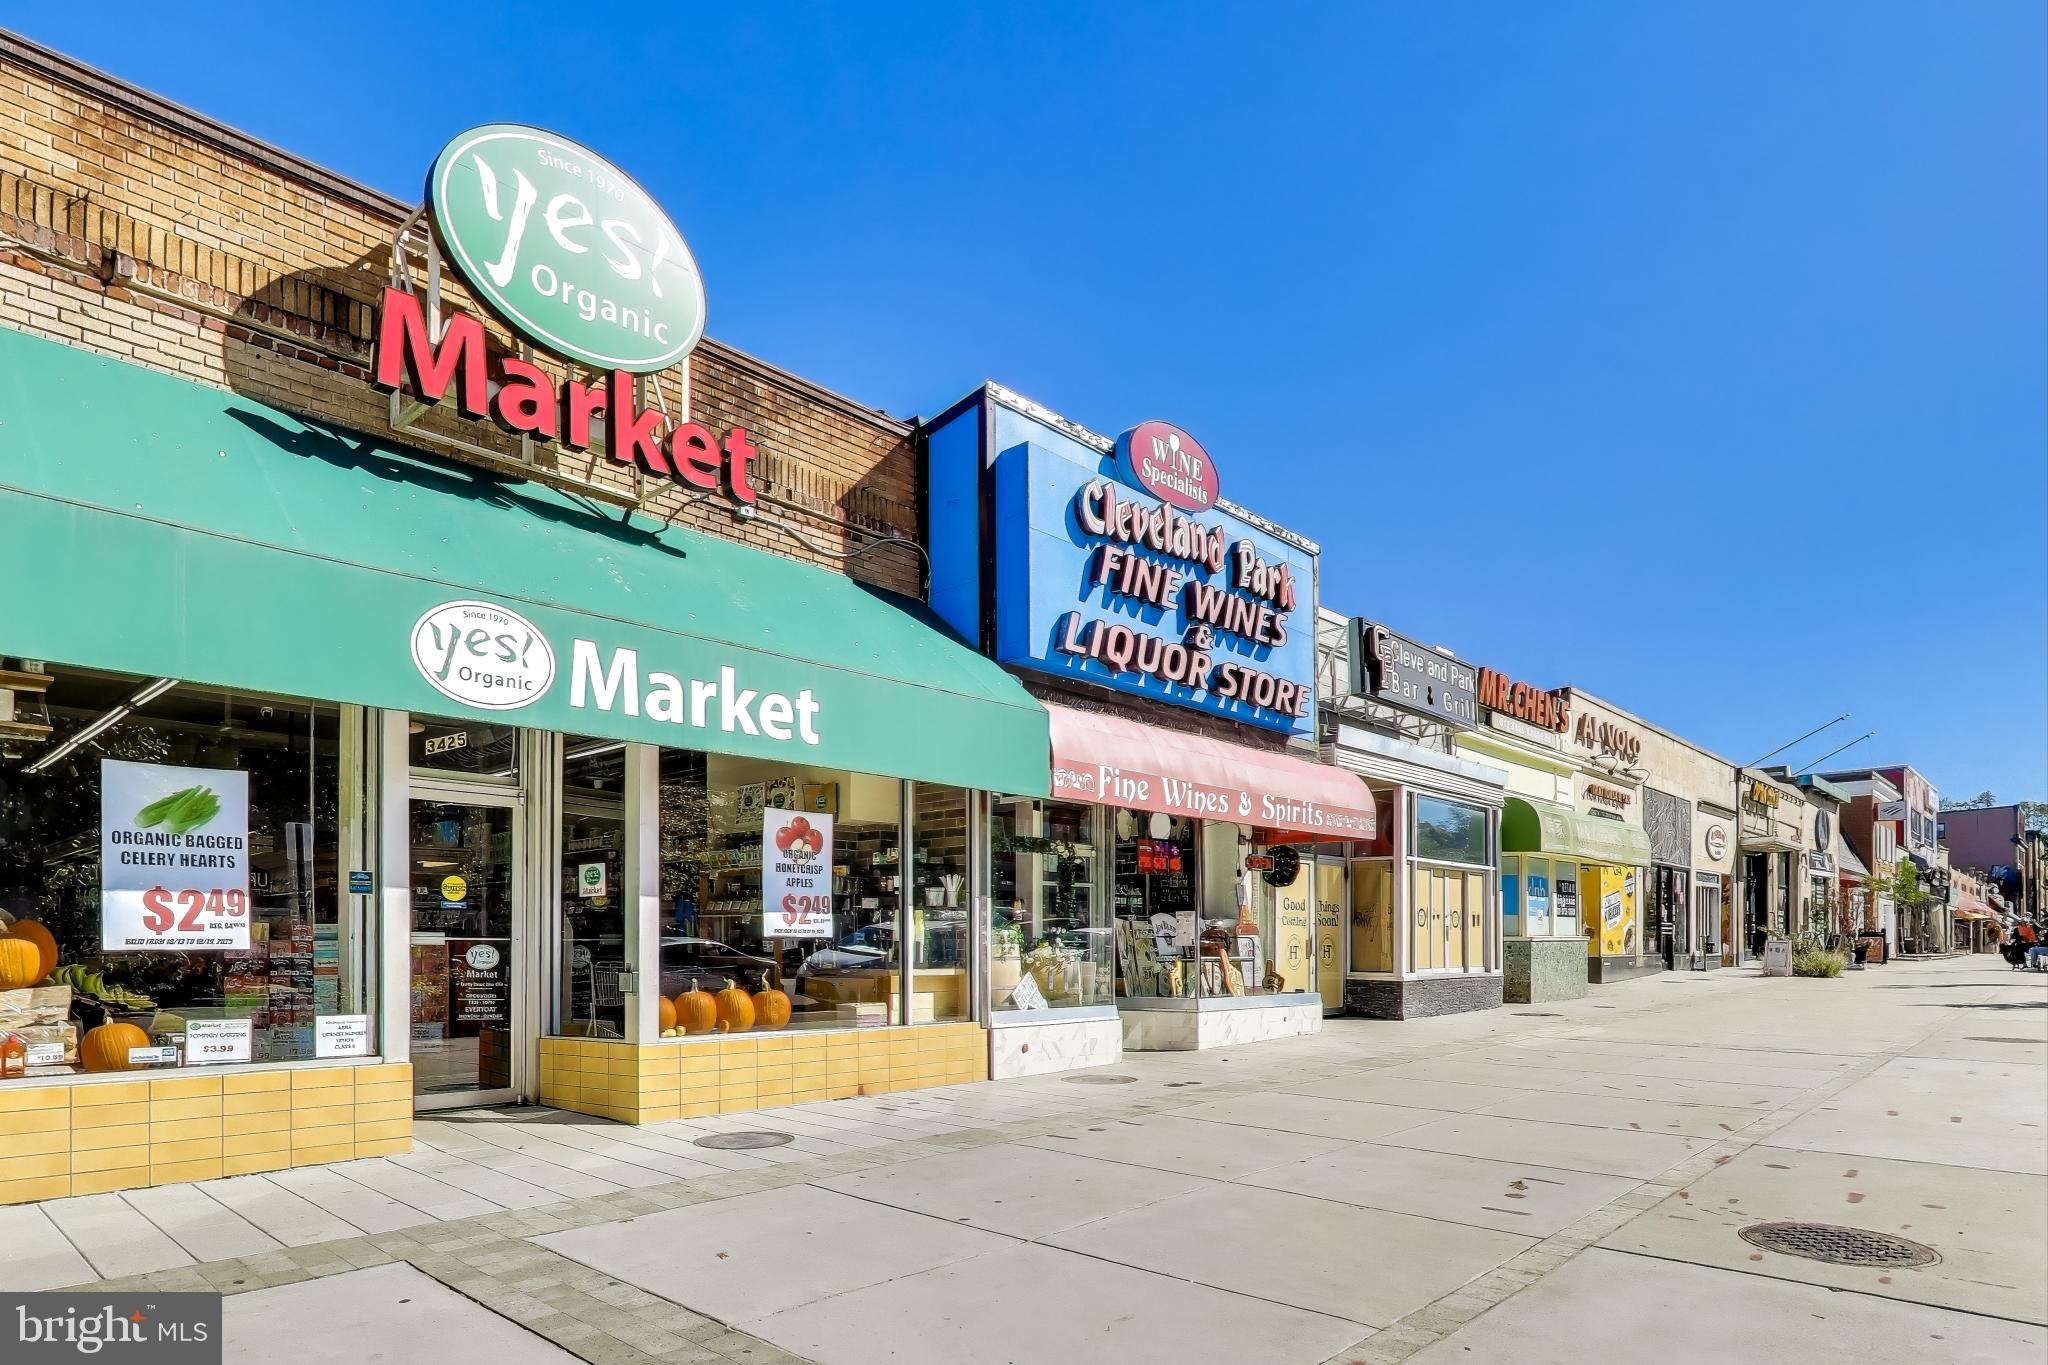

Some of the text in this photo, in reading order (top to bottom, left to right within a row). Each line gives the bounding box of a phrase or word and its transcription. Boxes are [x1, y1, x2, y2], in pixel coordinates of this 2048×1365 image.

[537, 149, 625, 202] Since 1970
[472, 153, 670, 298] yes!
[531, 265, 669, 346] Organic
[375, 286, 758, 504] Market
[1142, 457, 1208, 505] Specialists
[1152, 434, 1203, 481] WINE
[1077, 478, 1296, 612] Cleveland Park
[462, 609, 509, 626] Since 1970
[1096, 544, 1288, 648] FINE WINES
[429, 621, 534, 681] yes!
[1192, 625, 1213, 650] &
[459, 666, 533, 693] Organic
[1059, 611, 1312, 718] LIQUOR STORE
[1391, 640, 1424, 673] Cleve
[1427, 660, 1448, 682] and
[1451, 666, 1475, 694] Park
[569, 638, 820, 745] Market
[1392, 672, 1418, 699] Bar
[1443, 692, 1476, 721] Grill
[427, 734, 466, 754] 3425
[1097, 765, 1323, 826] Fine Wines & Spirits
[111, 830, 243, 849] ORGANIC BAGGED
[121, 851, 236, 868] CELERY HEARTS
[783, 849, 817, 861] ORGANIC
[776, 863, 823, 874] HONEYCRISP
[786, 878, 813, 888] APPLES
[1283, 897, 1306, 911] Good
[466, 970, 498, 978] Market
[471, 950, 495, 964] yes!
